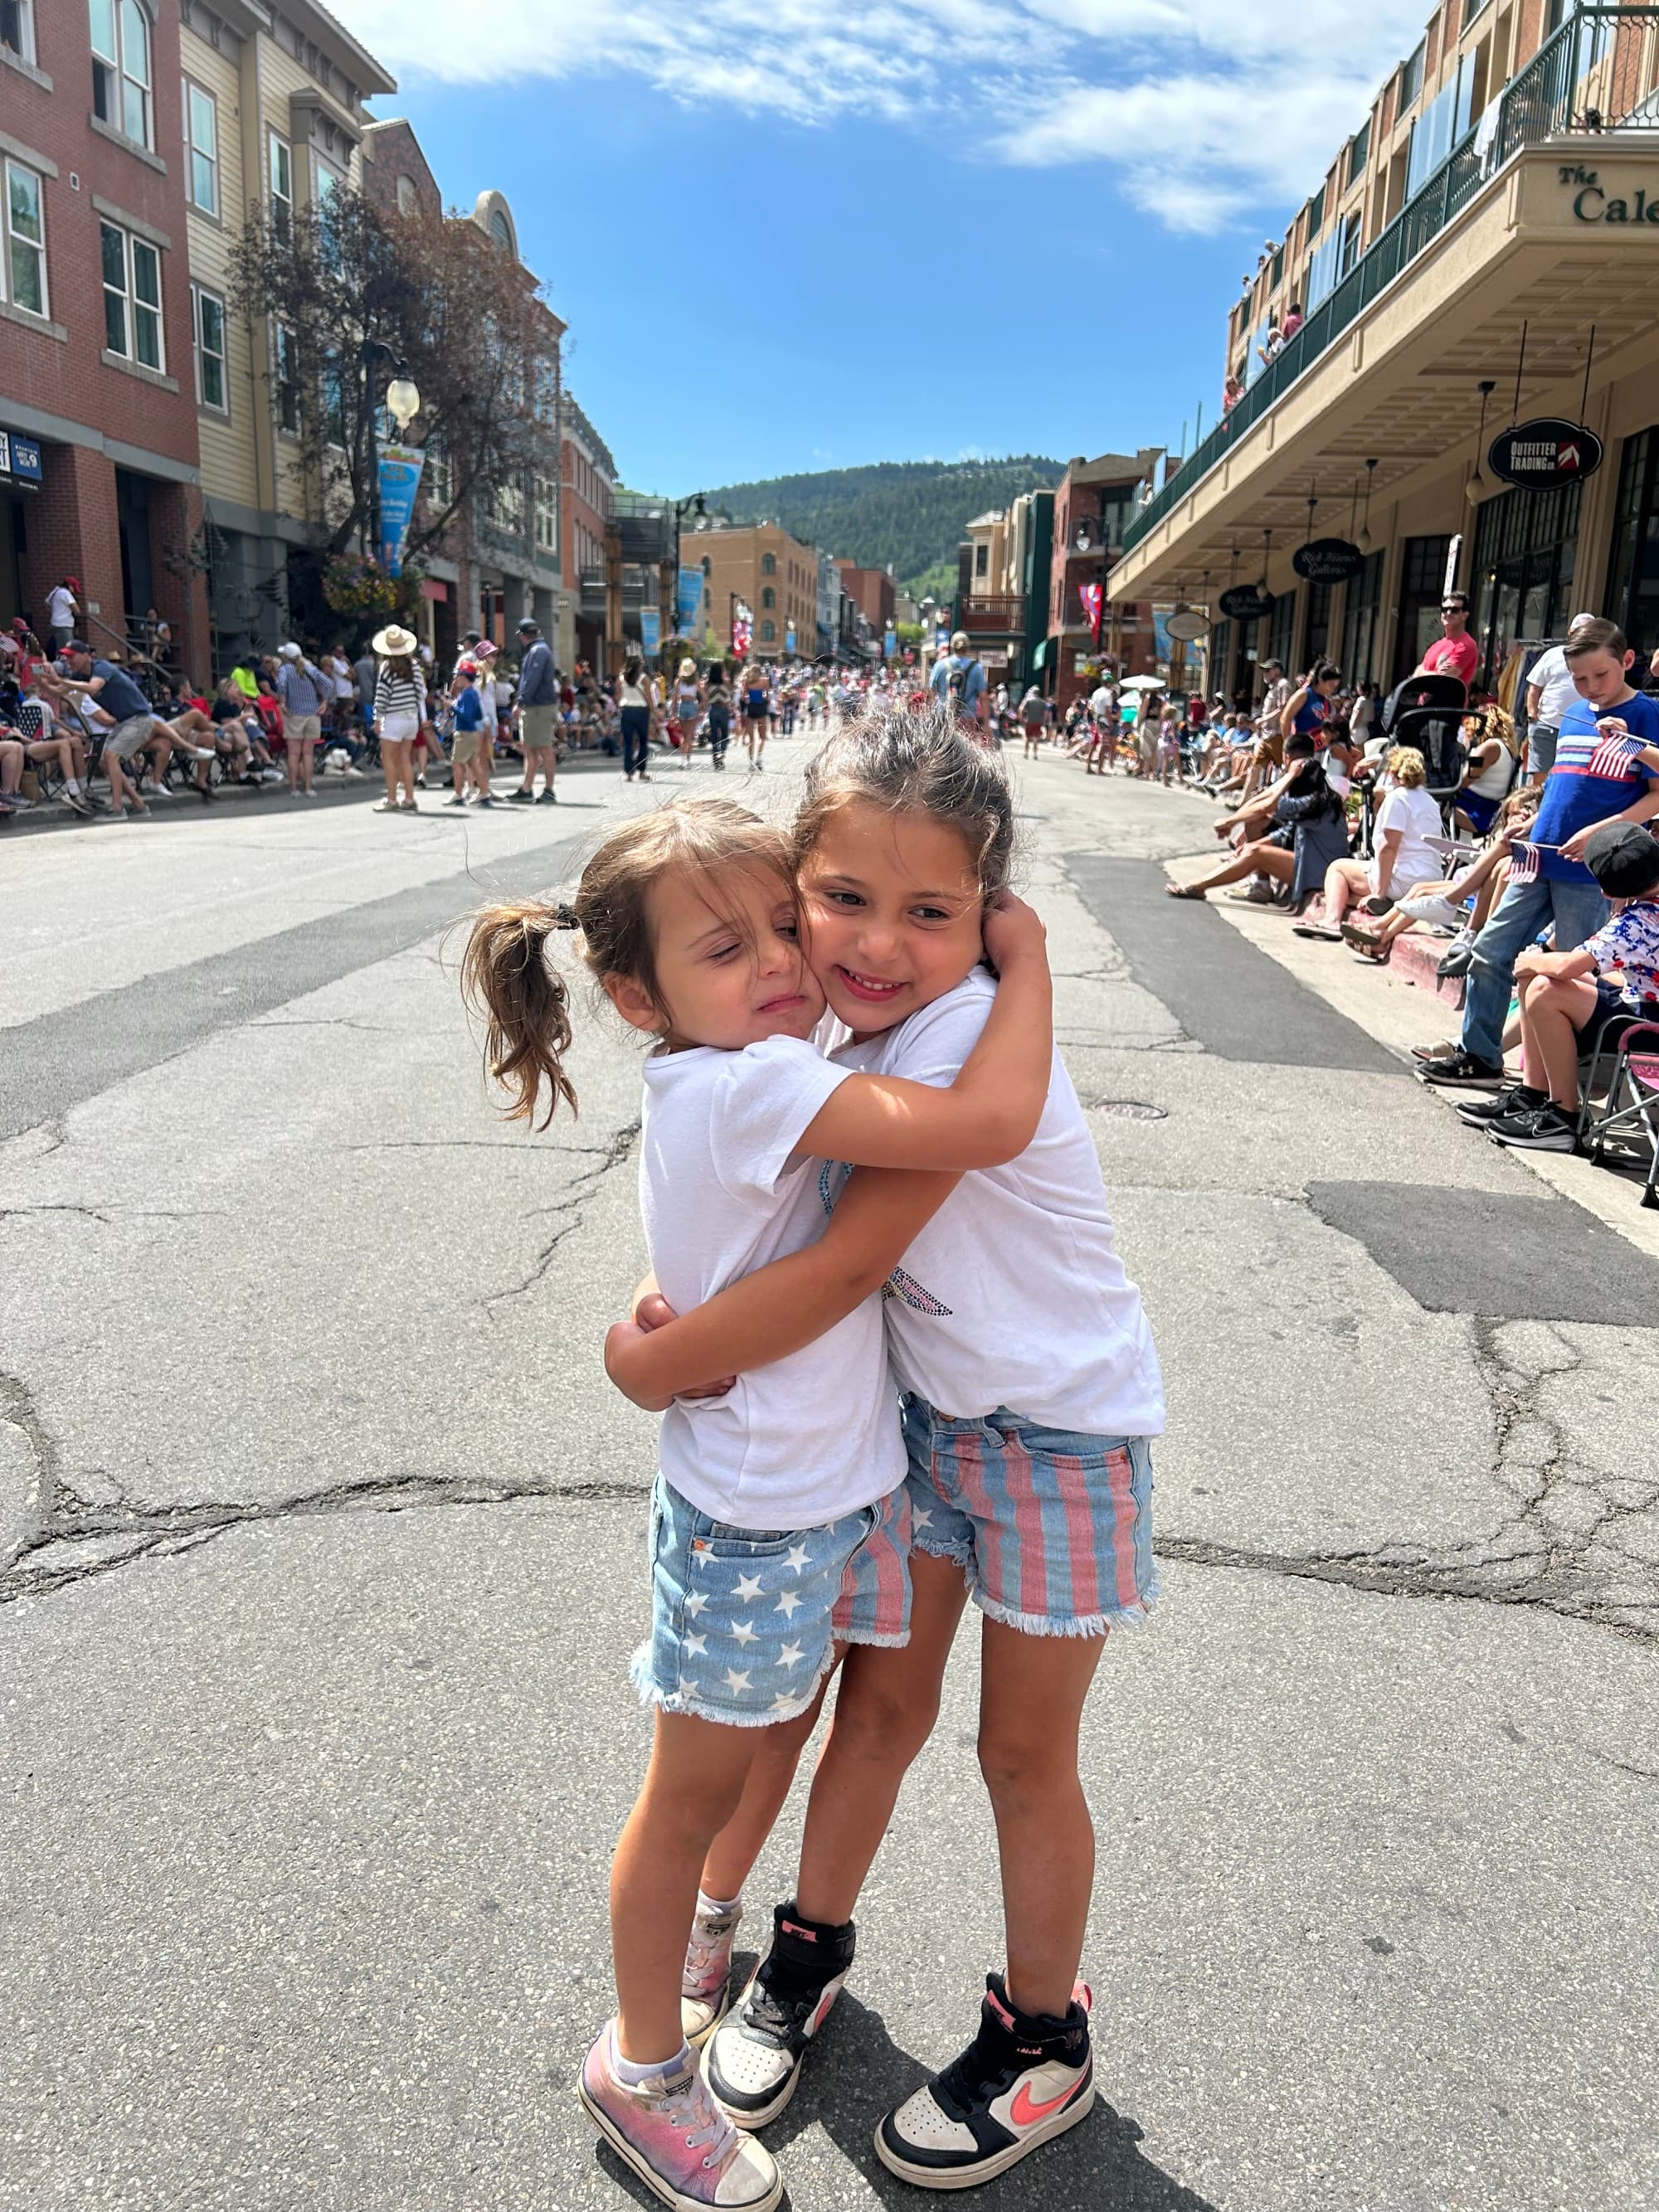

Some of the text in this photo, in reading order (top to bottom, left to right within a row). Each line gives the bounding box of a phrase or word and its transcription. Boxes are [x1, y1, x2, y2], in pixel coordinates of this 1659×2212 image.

[1559, 165, 1598, 183] The
[1574, 187, 1659, 222] Cale
[1511, 441, 1556, 456] OUTFITTER
[1511, 456, 1548, 470] TRADING
